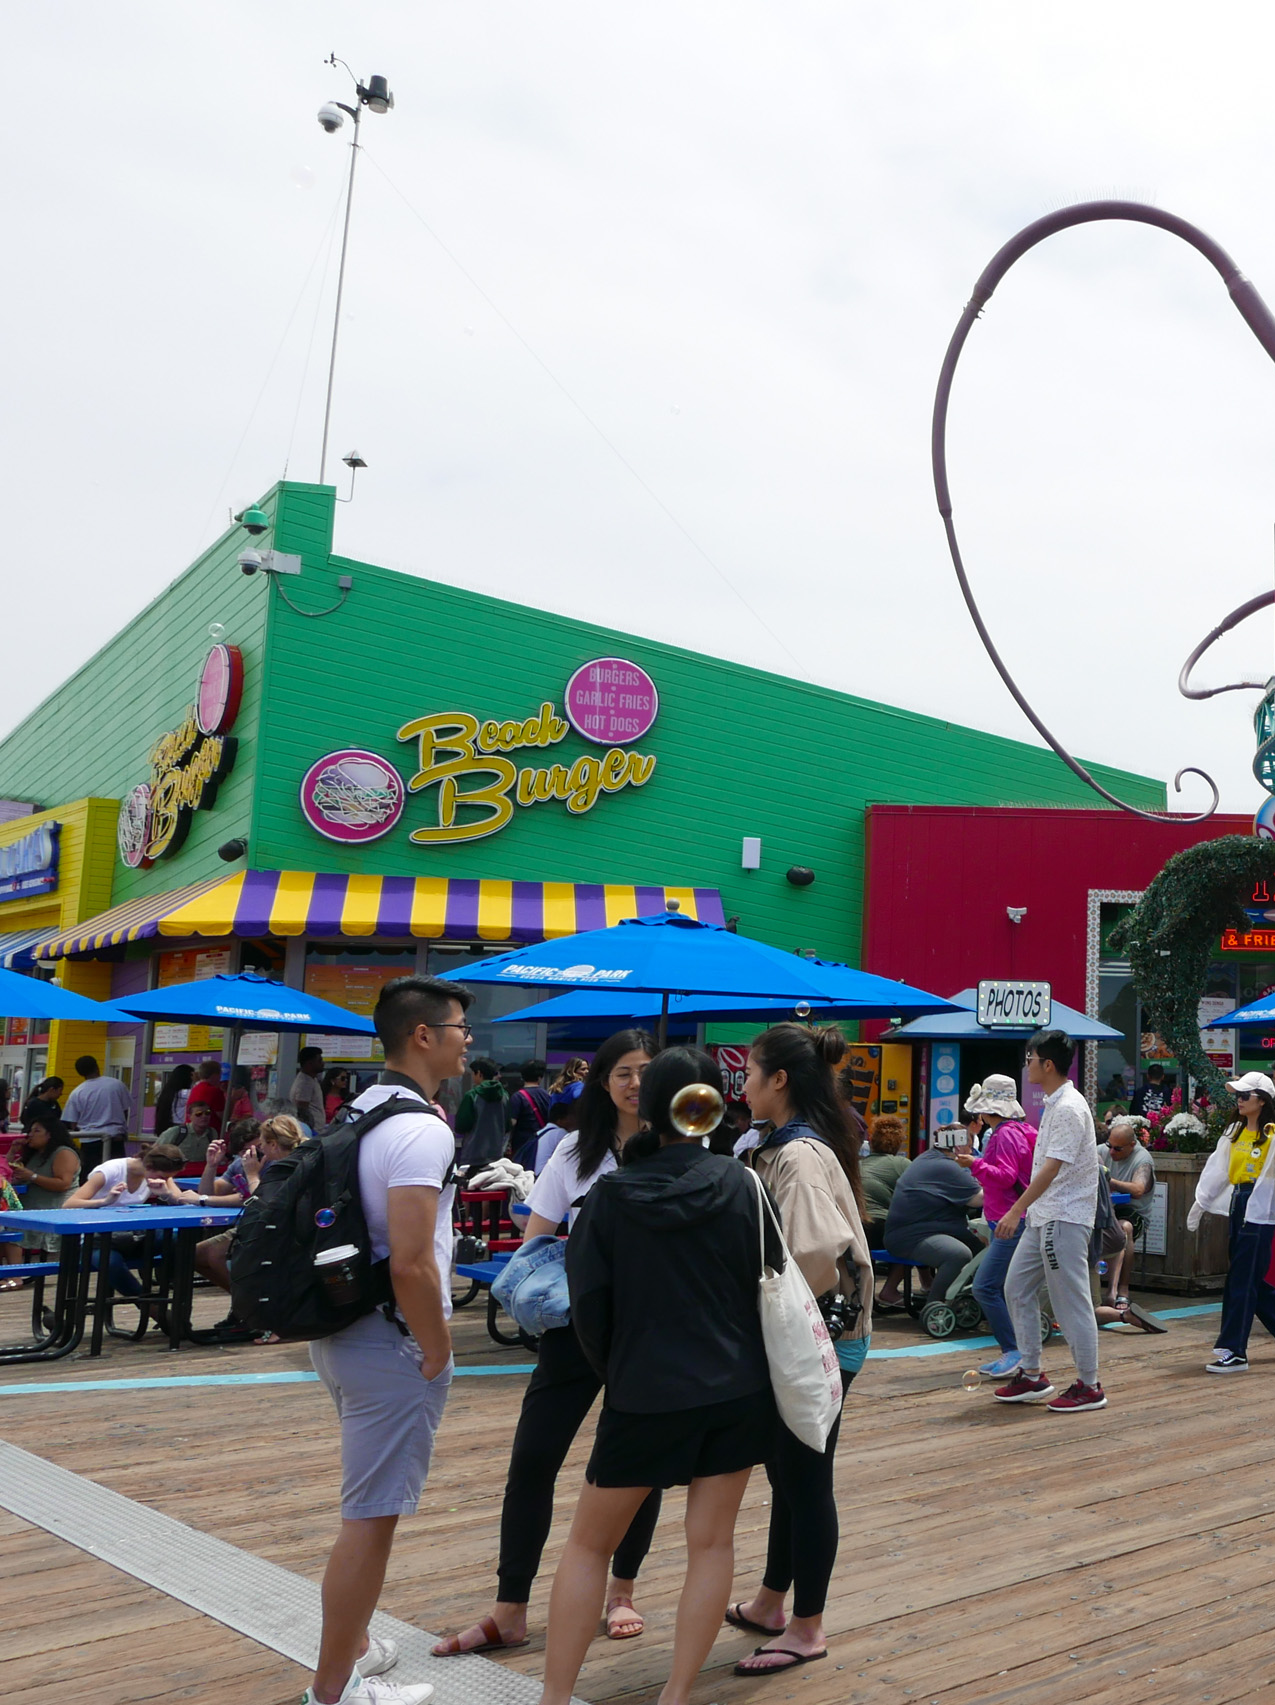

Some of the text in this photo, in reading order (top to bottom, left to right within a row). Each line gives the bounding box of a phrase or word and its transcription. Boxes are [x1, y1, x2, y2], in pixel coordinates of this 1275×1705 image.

[589, 667, 640, 686] BURGERS
[576, 689, 650, 711] GARLIC FRIES
[584, 714, 640, 733] HOT DOGS
[397, 701, 569, 771] Beach
[407, 748, 657, 845] Burger
[1227, 934, 1239, 946] &
[501, 964, 636, 979] PACIFIC PARK
[215, 1005, 256, 1016] PACIFIC
[283, 1011, 311, 1021] PARK
[986, 988, 1042, 1018] PHOTOS
[1044, 1240, 1060, 1271] KLEIN
